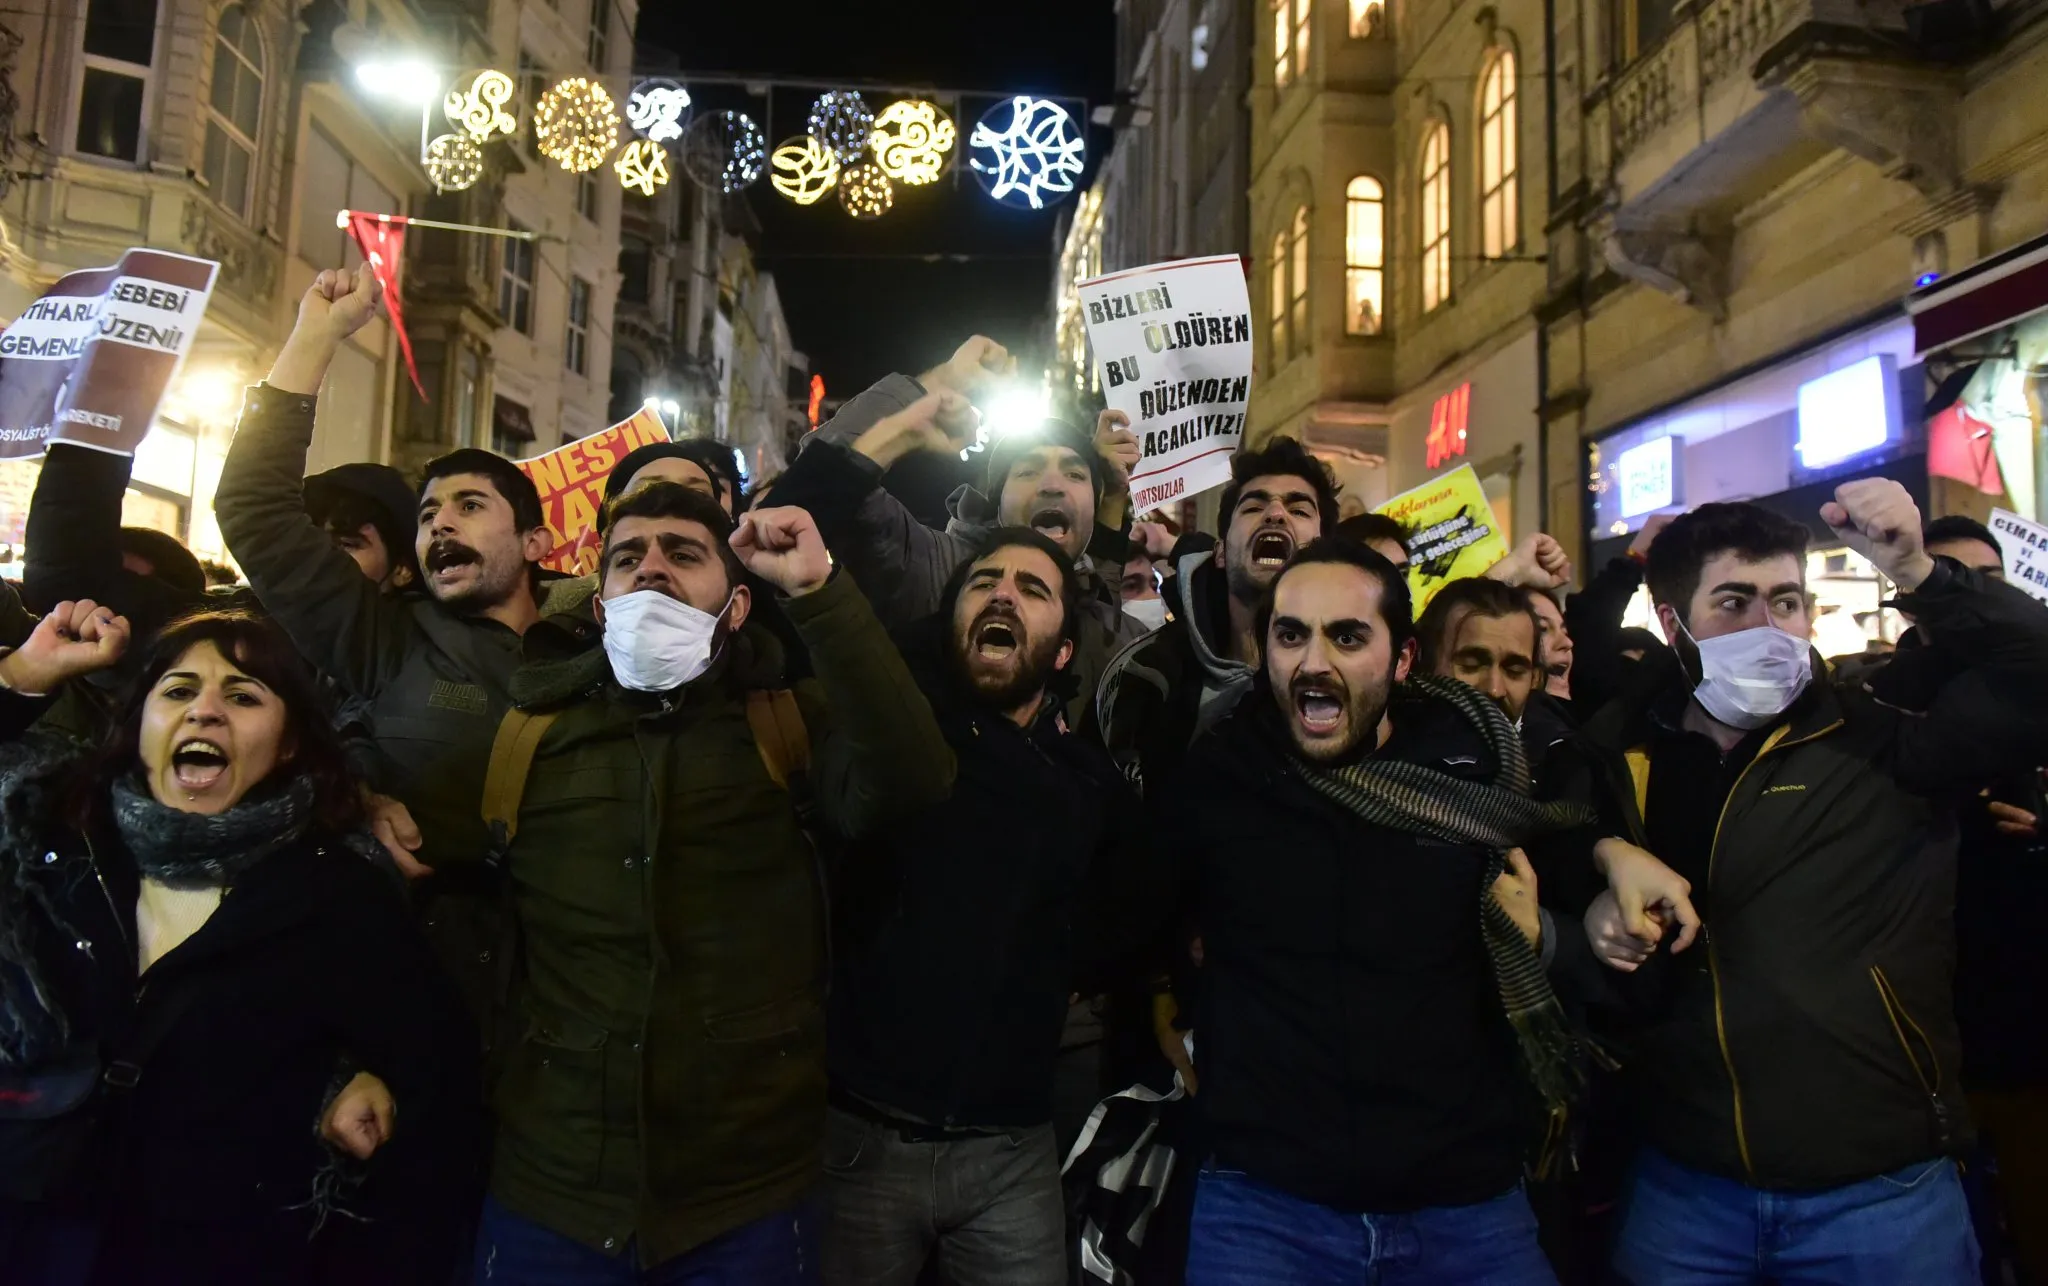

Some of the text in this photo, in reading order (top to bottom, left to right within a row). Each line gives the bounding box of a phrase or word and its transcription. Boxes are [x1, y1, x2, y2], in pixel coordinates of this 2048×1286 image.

[1089, 281, 1173, 325] BİZLERİ
[1141, 312, 1249, 354] ÖLDÜREN
[1106, 355, 1141, 388] BU
[1140, 376, 1249, 420] DÜZENDEN
[516, 406, 667, 496] NES'İN
[1136, 412, 1245, 458] ACAKLIYIZ!
